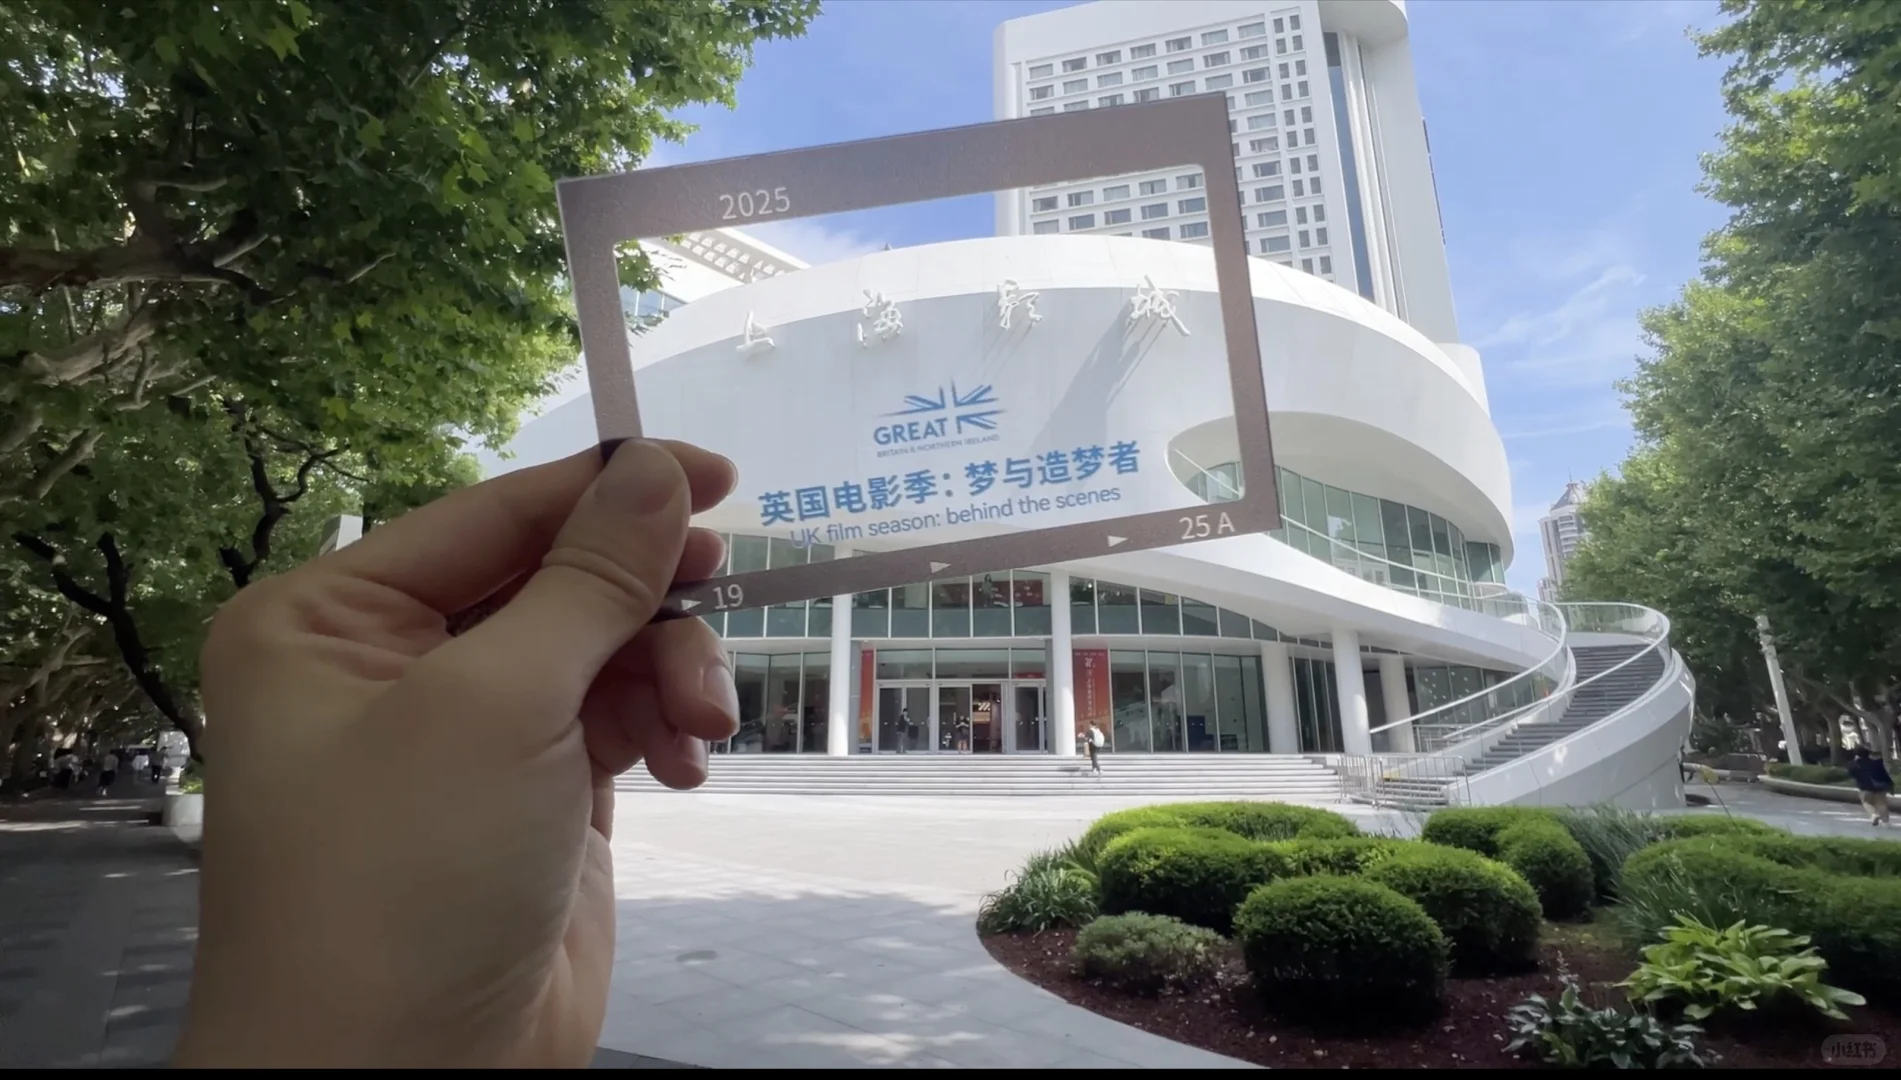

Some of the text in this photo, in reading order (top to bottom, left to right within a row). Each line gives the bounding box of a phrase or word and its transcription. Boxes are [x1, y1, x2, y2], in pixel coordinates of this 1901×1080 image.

[719, 186, 791, 220] 2025
[873, 417, 948, 446] GREAT
[877, 448, 908, 458] BRITAIN
[917, 439, 962, 452] NORTHERN
[964, 434, 1000, 446] IRELAND
[790, 487, 1121, 549] UK film season: behind the scenes
[712, 583, 744, 610] 19
